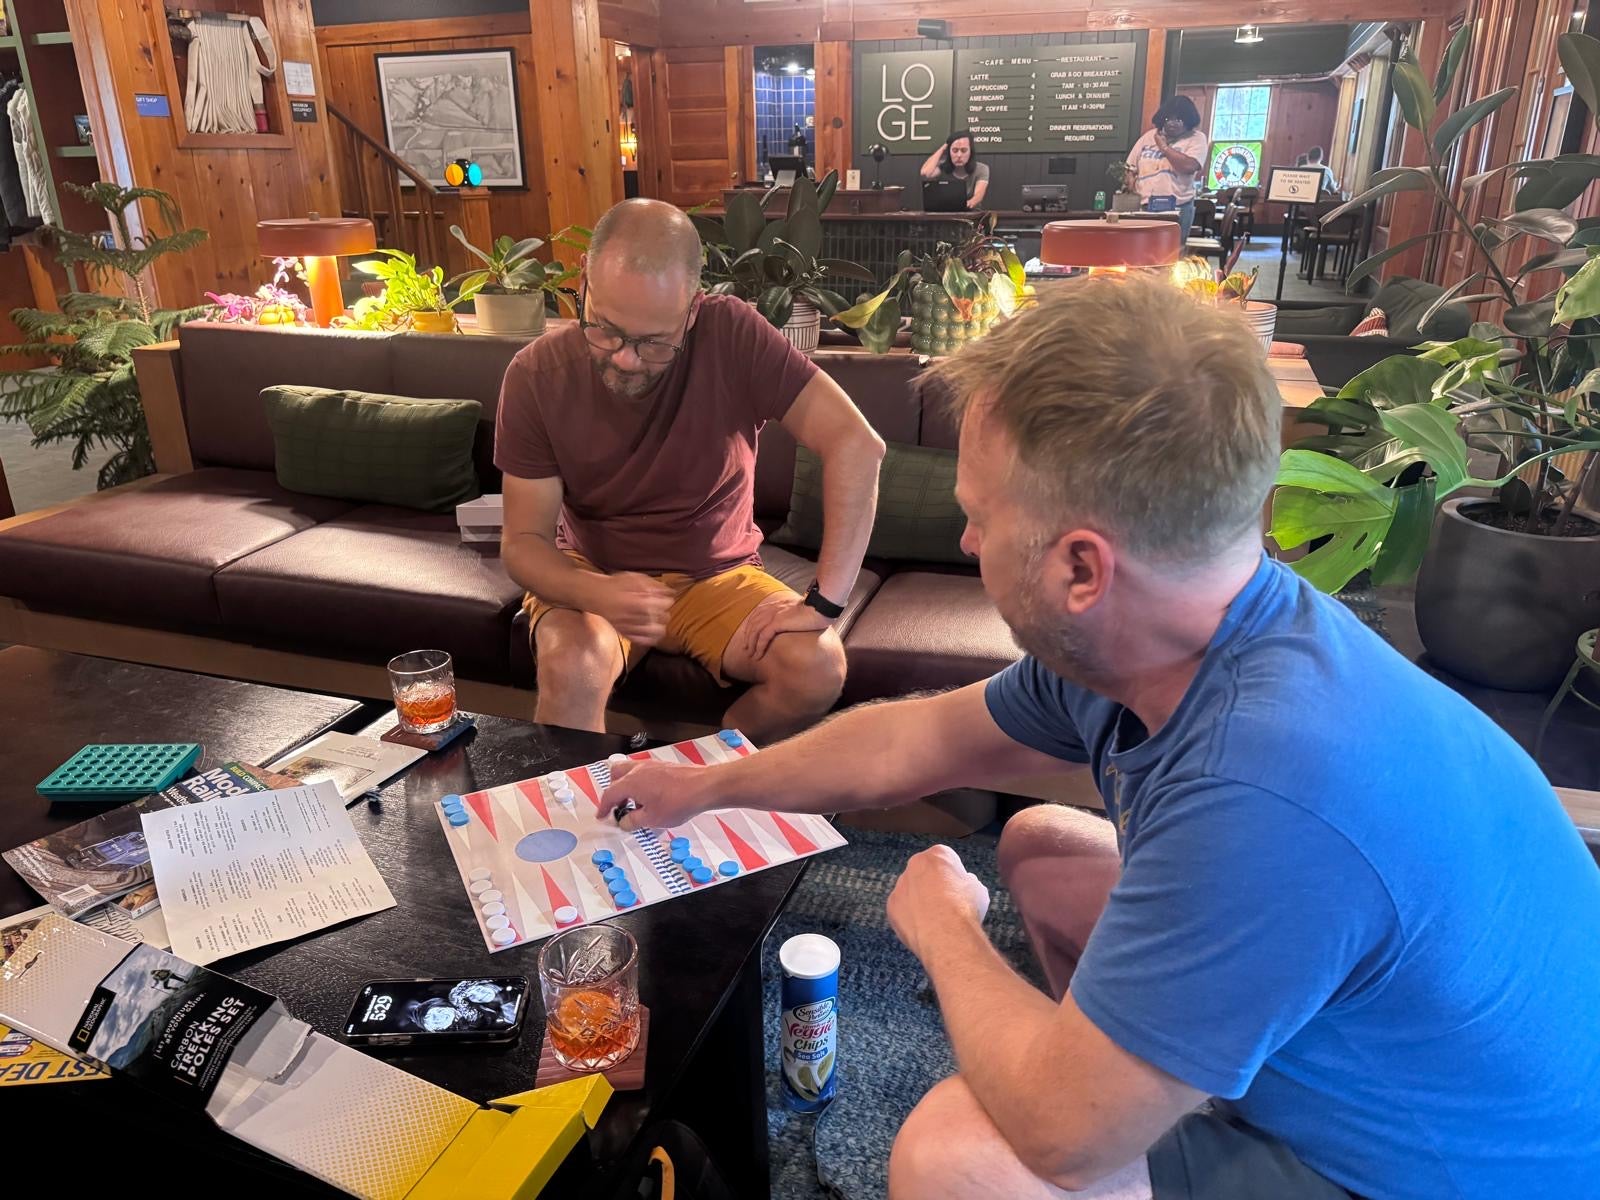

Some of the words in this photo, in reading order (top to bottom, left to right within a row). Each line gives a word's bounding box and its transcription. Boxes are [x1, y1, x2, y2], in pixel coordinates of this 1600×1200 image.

[882, 64, 935, 102] LO
[877, 104, 933, 141] GE
[202, 767, 249, 796] Mod
[84, 1003, 99, 1029] NATIONAL
[87, 997, 106, 1030] GEOGRAPHIC
[369, 995, 392, 1021] 5:29
[156, 1040, 165, 1054] LET
[164, 1000, 193, 1040] ADVENTURE
[166, 1033, 174, 1044] BE
[170, 1012, 186, 1033] YOUR
[178, 996, 235, 1071] TREKKING
[188, 1026, 222, 1077] POLES
[220, 998, 246, 1024] SET
[785, 1017, 834, 1039] Veggie
[794, 1036, 828, 1050] Chips
[170, 1020, 197, 1068] CARBON
